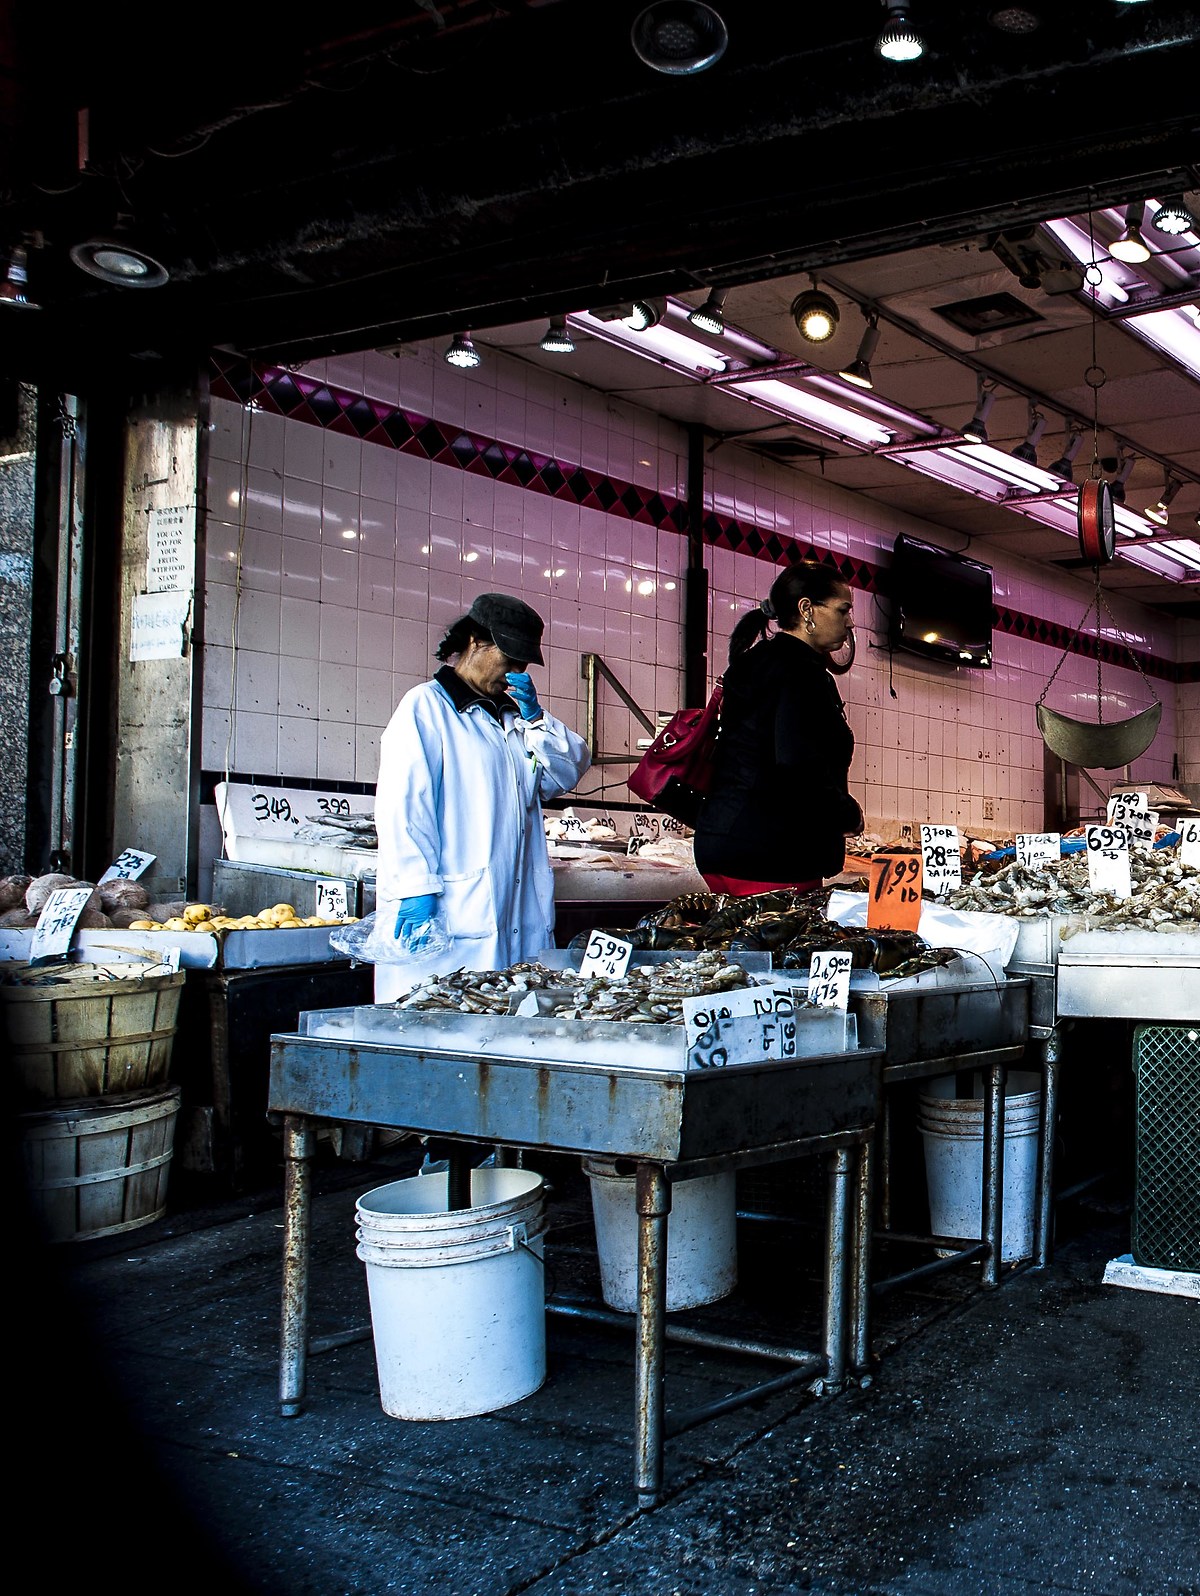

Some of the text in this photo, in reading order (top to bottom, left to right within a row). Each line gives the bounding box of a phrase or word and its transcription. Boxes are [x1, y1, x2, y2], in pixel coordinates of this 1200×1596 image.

[170, 530, 182, 538] CAN
[158, 557, 178, 565] FRUITS
[922, 826, 932, 843] 3
[1017, 835, 1026, 849] 3
